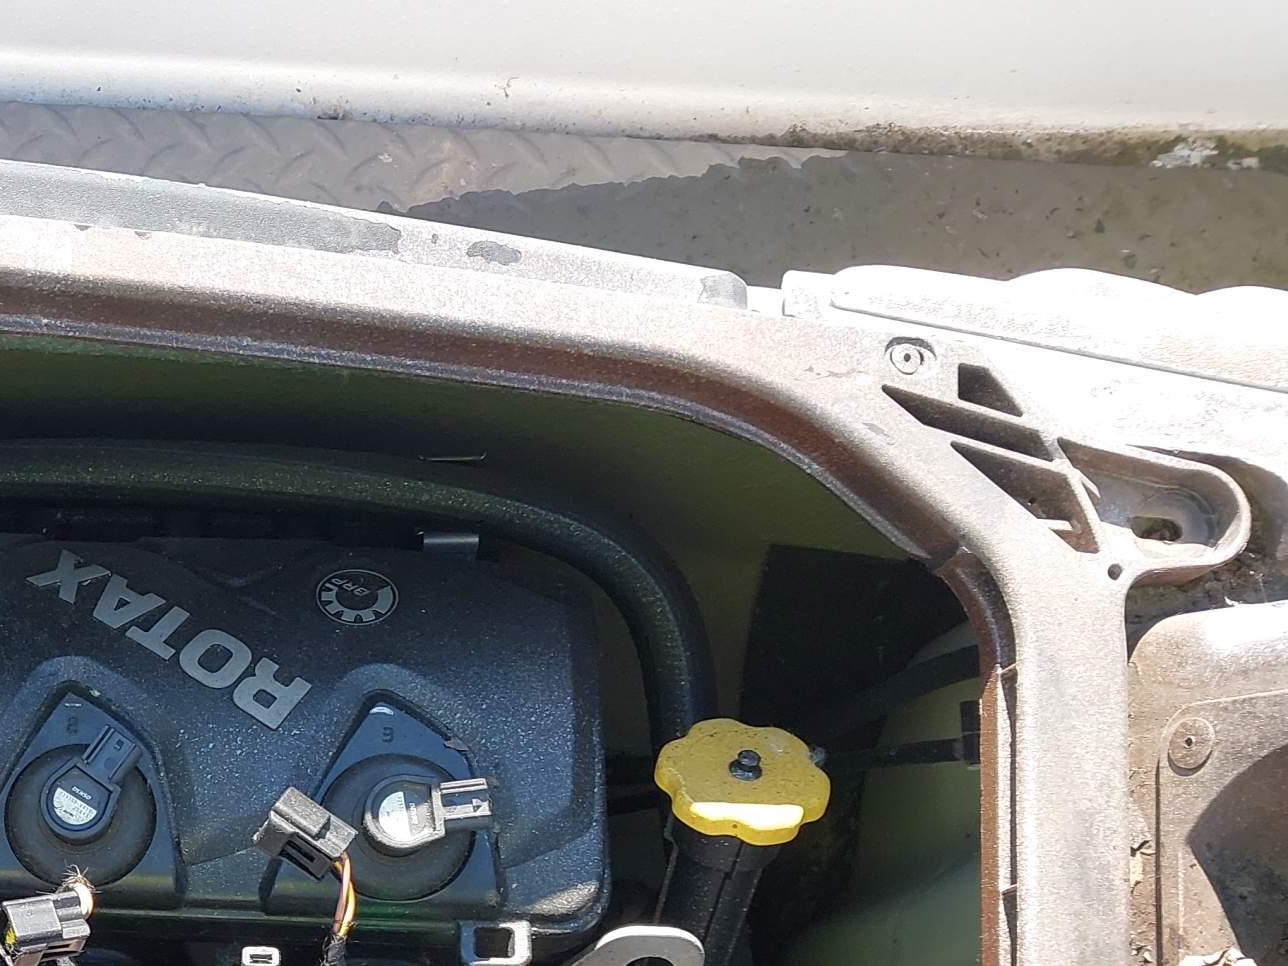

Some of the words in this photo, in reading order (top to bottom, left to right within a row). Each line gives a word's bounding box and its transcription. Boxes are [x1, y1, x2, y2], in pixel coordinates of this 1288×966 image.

[330, 577, 370, 597] BRP
[26, 548, 314, 731] ROTAX
[71, 784, 92, 801] DENSO
